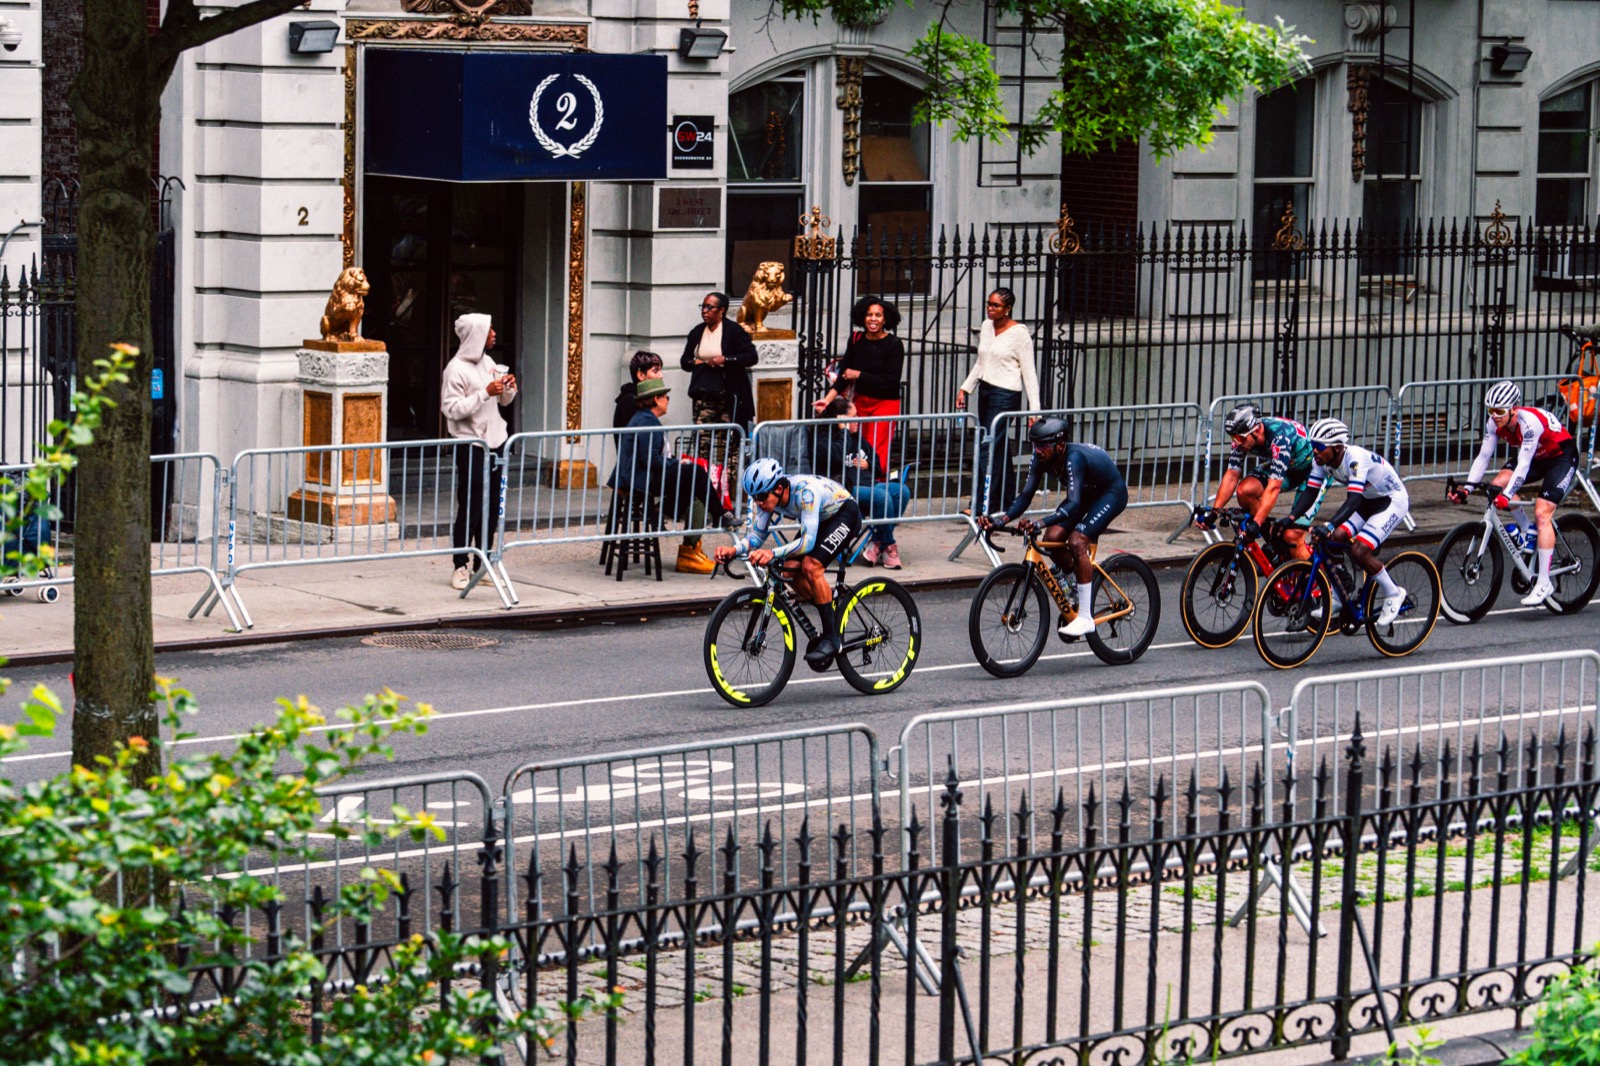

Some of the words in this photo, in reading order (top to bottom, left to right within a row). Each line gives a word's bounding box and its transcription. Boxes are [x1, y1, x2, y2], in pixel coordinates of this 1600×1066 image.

[555, 92, 577, 130] 2
[297, 206, 309, 226] 2
[681, 207, 712, 215] STREET
